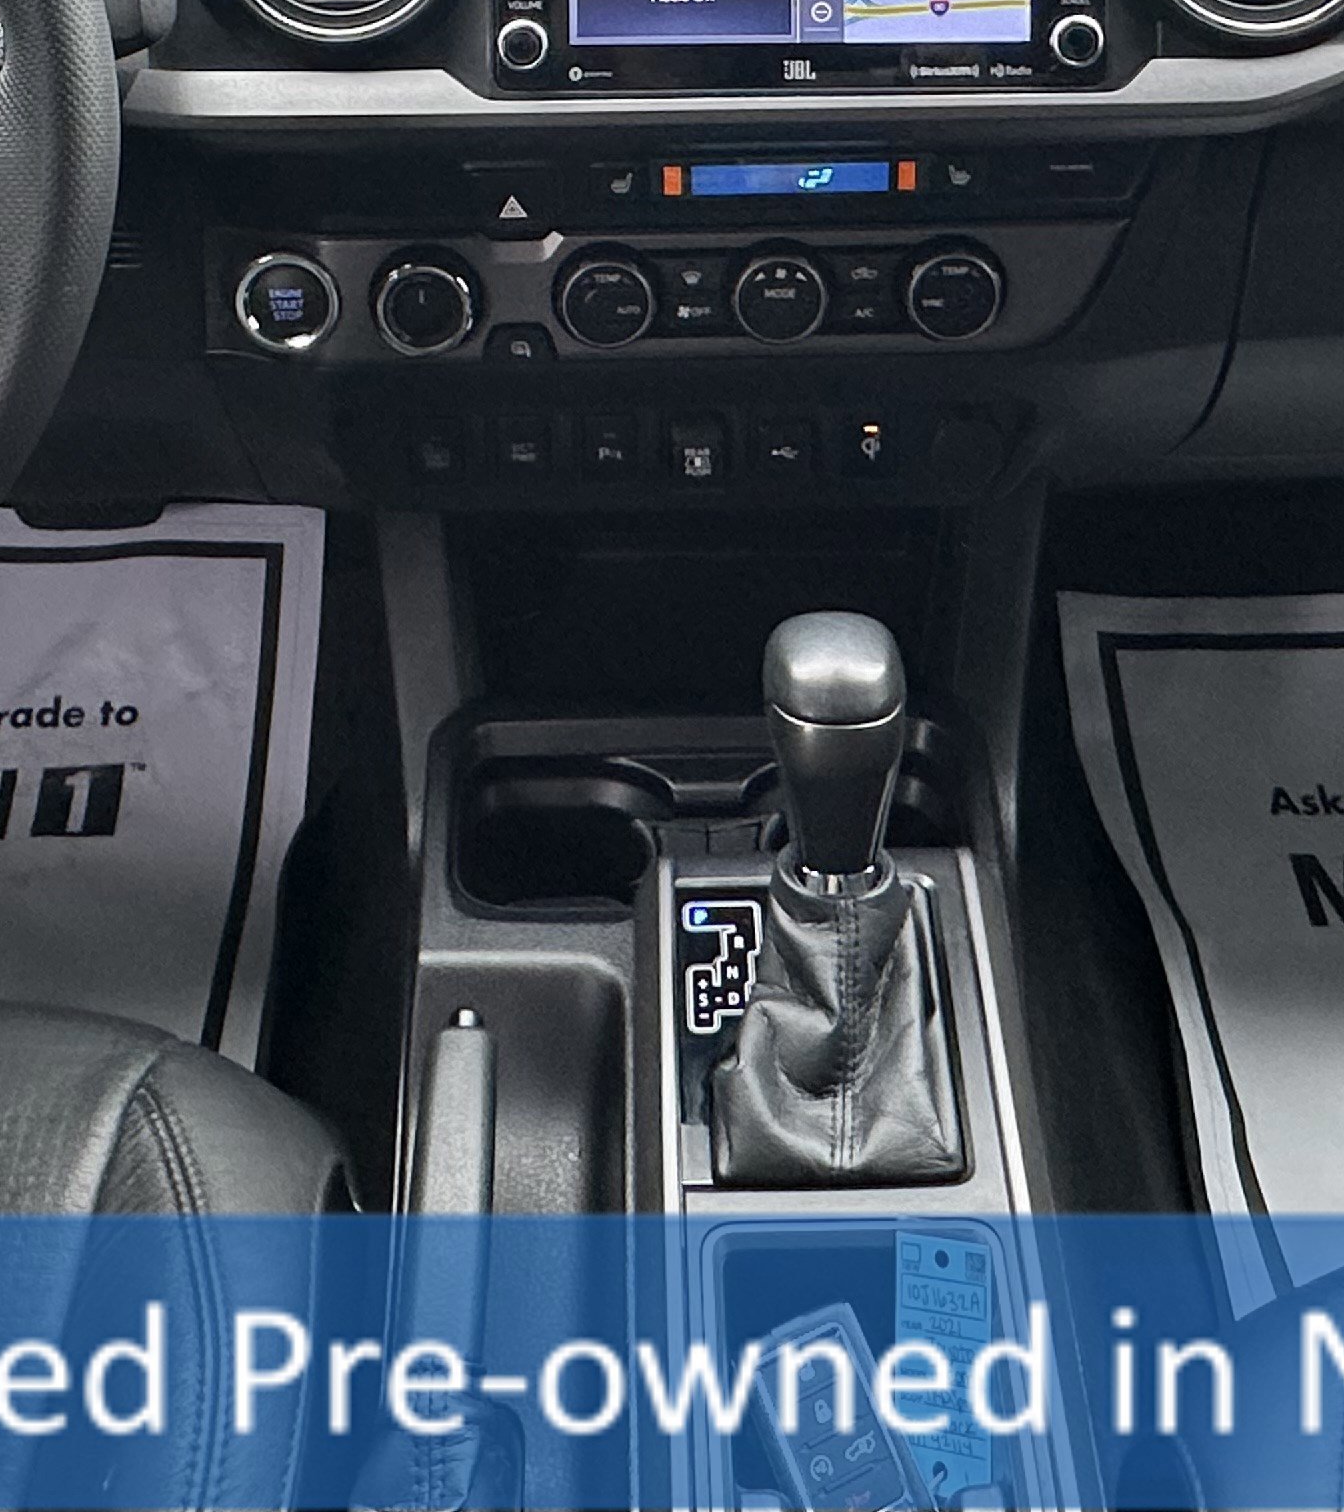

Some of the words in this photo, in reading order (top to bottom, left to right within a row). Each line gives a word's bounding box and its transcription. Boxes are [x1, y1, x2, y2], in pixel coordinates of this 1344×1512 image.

[783, 59, 816, 80] JBL
[100, 700, 140, 727] to
[726, 965, 740, 979] N
[698, 992, 709, 1008] S
[727, 991, 741, 1006] D
